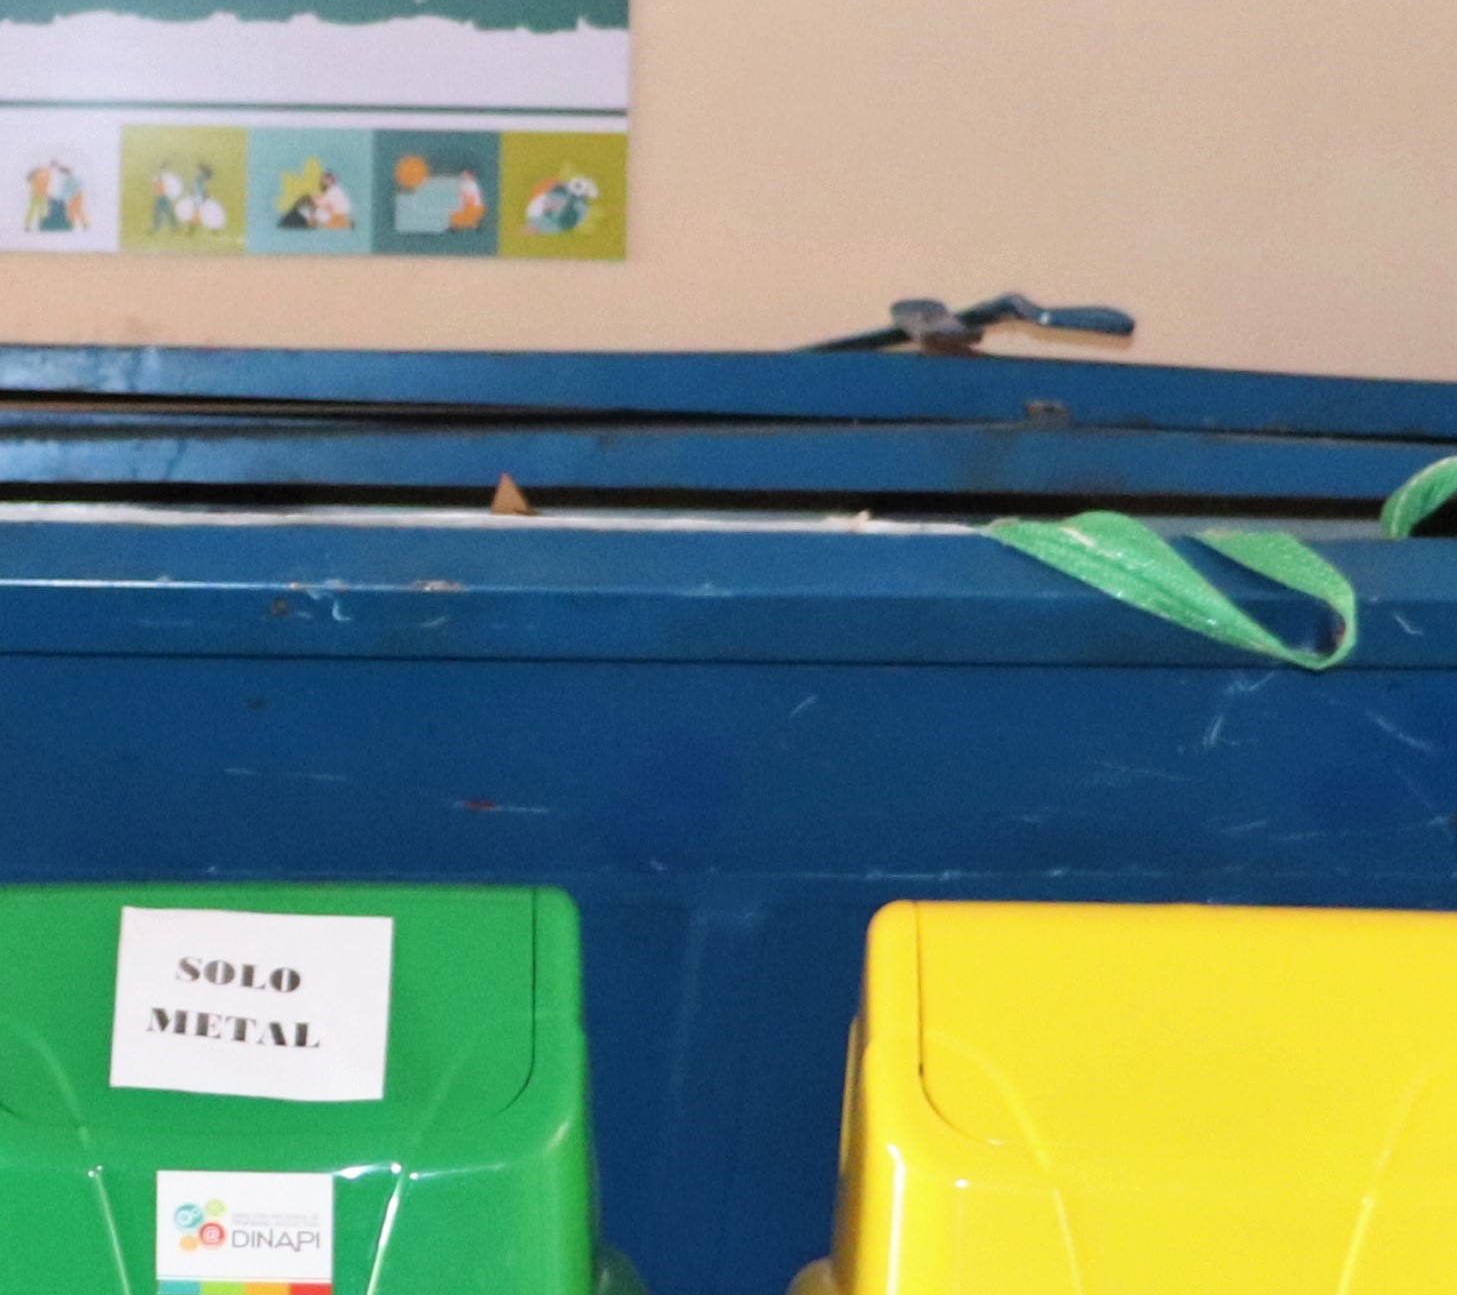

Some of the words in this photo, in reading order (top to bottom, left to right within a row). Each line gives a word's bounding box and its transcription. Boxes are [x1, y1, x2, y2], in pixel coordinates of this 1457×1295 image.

[176, 955, 302, 993] SOLO
[146, 1008, 320, 1049] METAL
[231, 1229, 320, 1252] DINAPI
